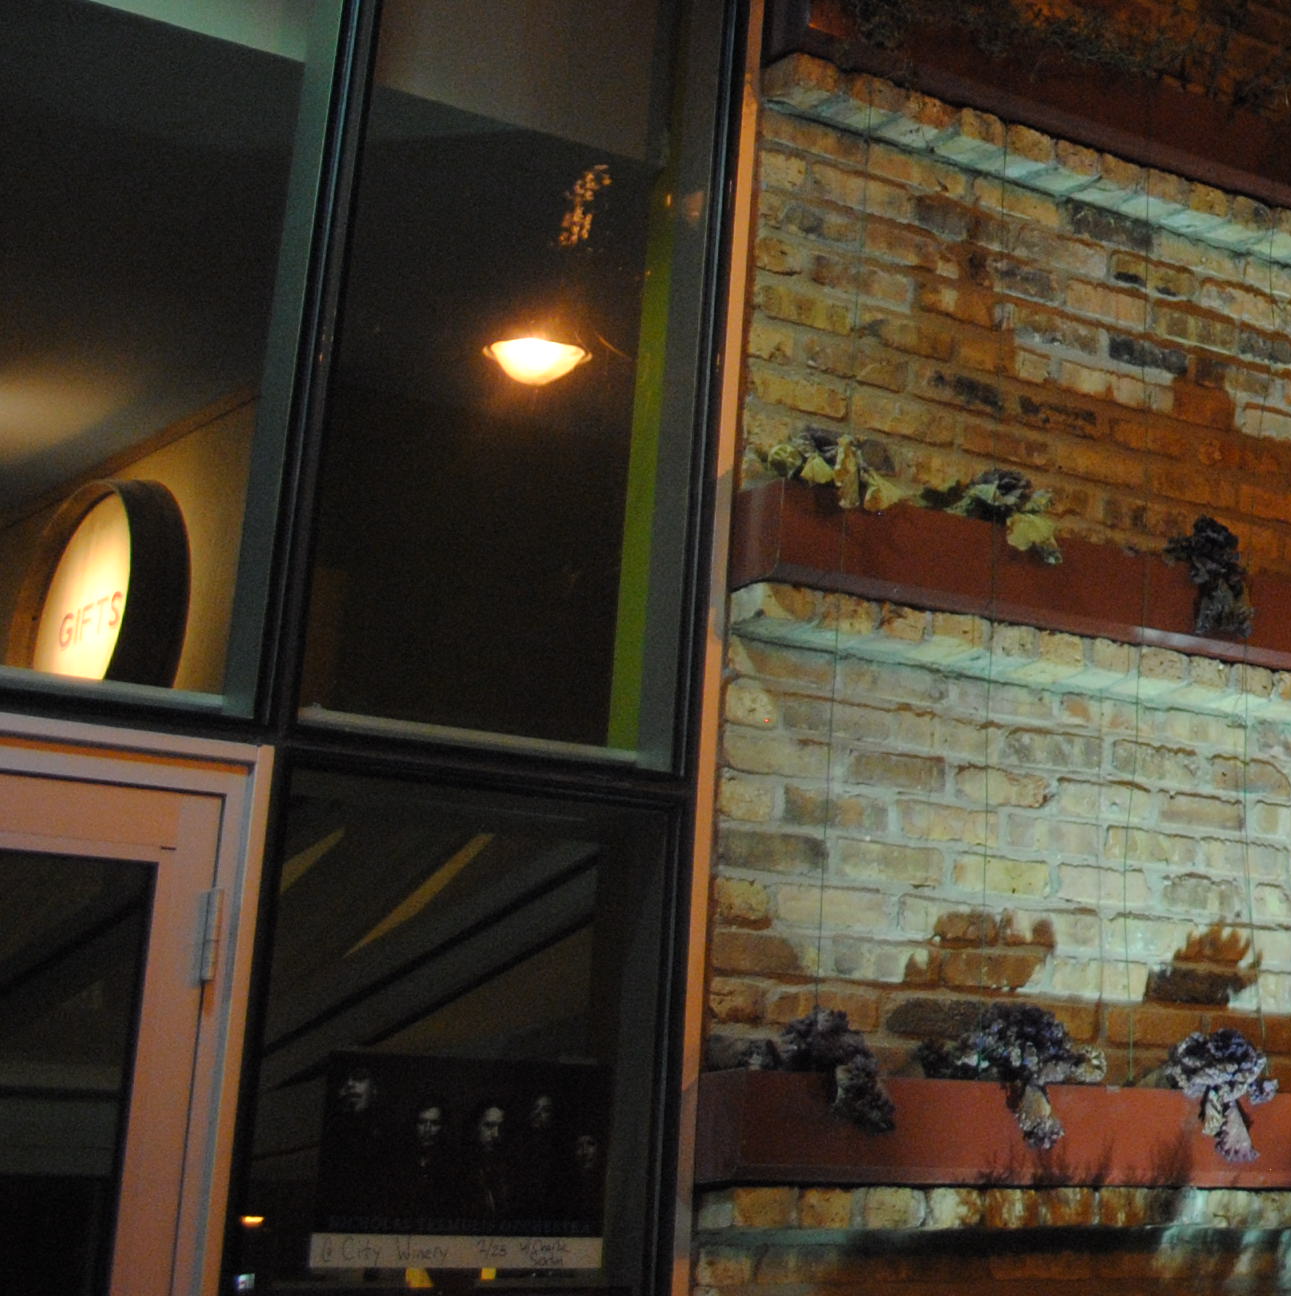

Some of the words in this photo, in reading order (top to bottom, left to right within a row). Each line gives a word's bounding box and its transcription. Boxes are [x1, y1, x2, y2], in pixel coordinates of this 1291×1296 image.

[58, 591, 123, 648] GIFTS
[341, 1235, 382, 1266] City
[396, 1235, 449, 1266] Winery
